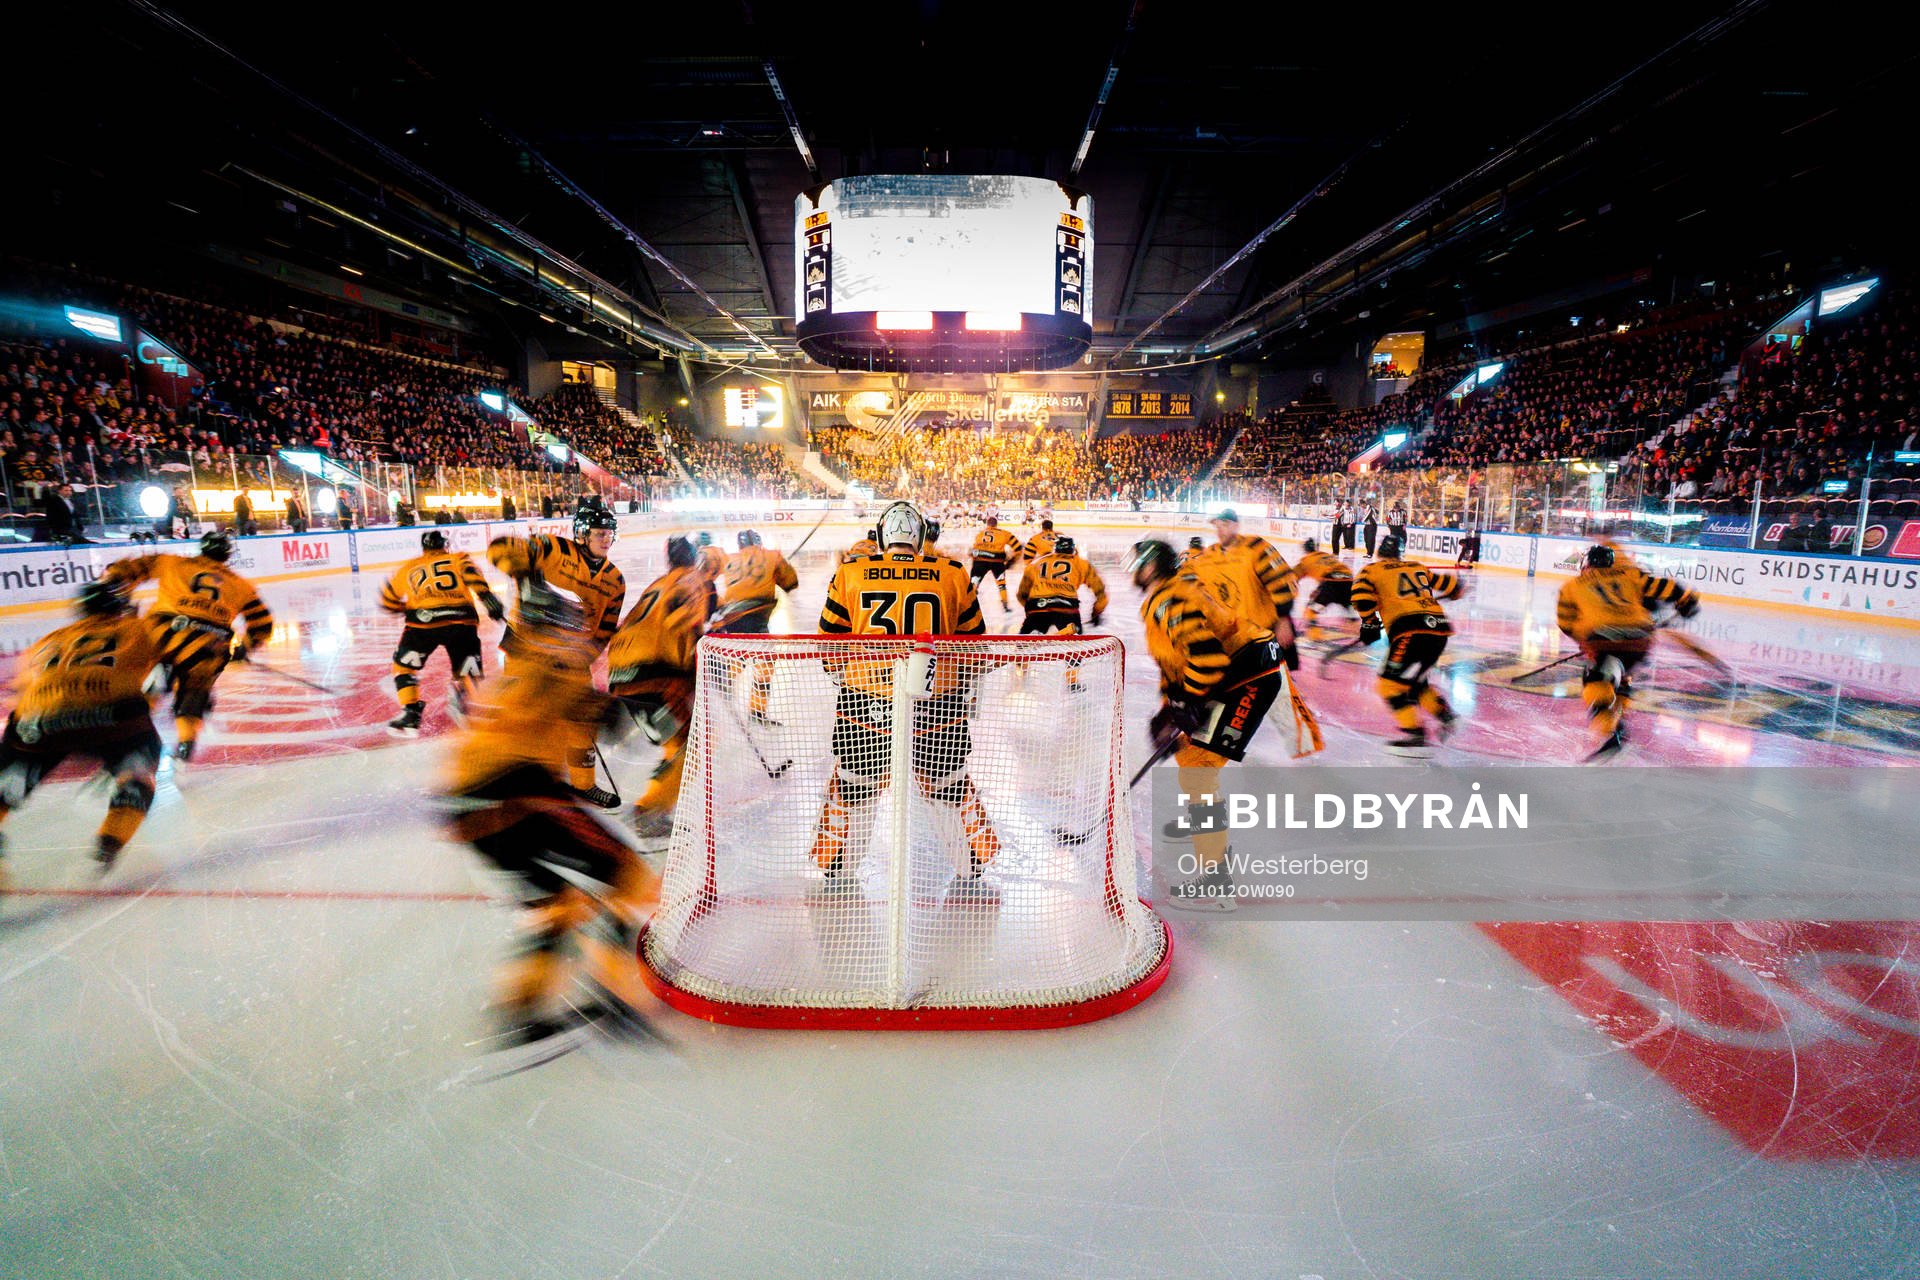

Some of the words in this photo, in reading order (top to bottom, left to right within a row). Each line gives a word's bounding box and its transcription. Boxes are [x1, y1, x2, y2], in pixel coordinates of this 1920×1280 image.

[812, 393, 841, 407] AIK
[1061, 395, 1084, 407] STÅ
[1112, 402, 1131, 414] 1978
[1140, 402, 1161, 414] 2013
[1170, 402, 1190, 414] 2014
[1409, 533, 1458, 554] BOLIDEN
[409, 560, 459, 594] 25
[868, 567, 940, 582] BOLIDEN
[1039, 560, 1072, 582] 12
[1760, 559, 1918, 590] SKIDSTAHUS
[861, 591, 941, 635] 30
[925, 658, 937, 692] SHL
